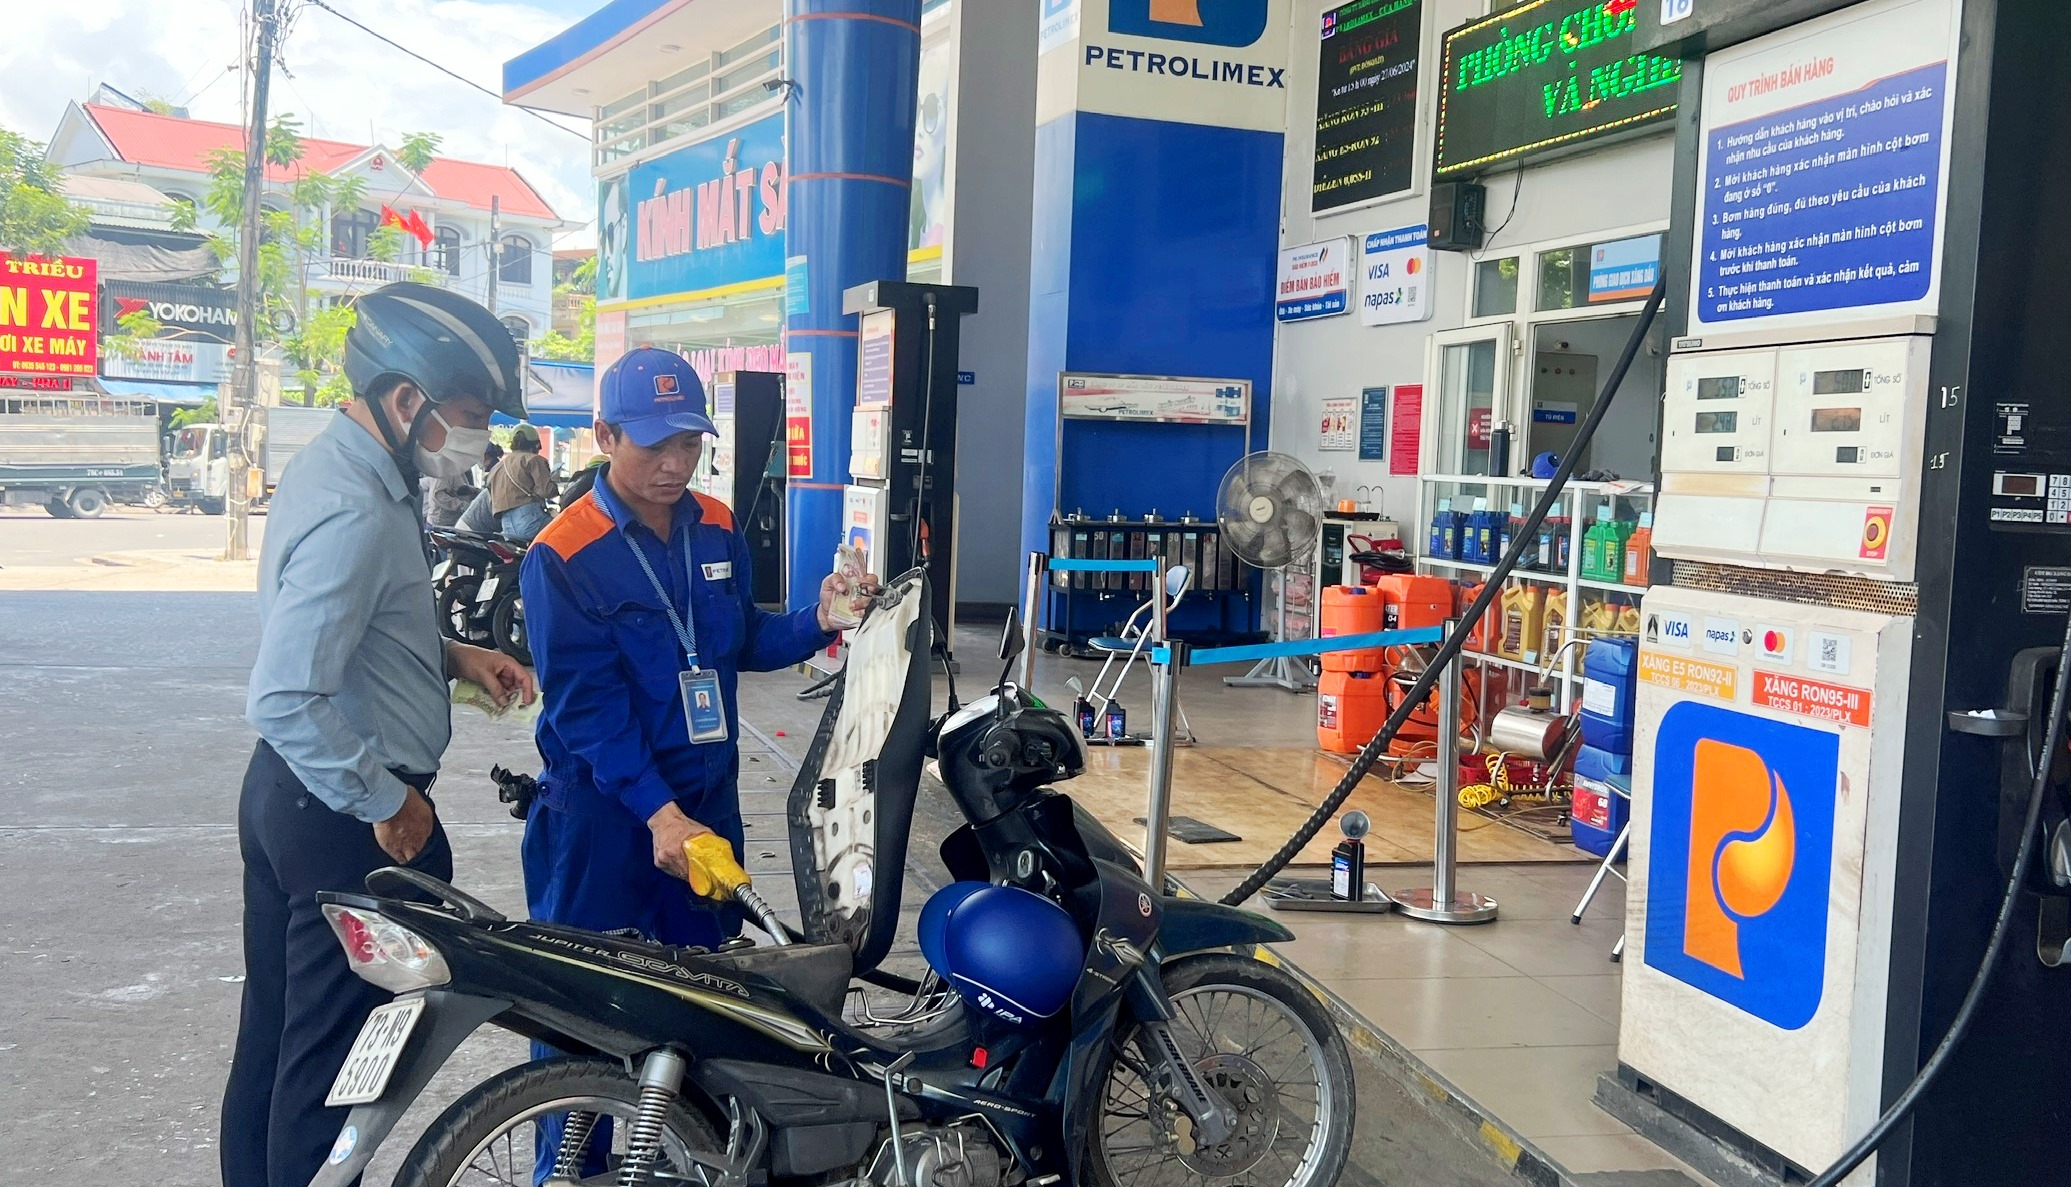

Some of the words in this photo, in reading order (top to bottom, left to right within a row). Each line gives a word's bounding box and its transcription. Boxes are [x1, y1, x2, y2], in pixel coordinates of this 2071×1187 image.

[1085, 44, 1285, 89] PETROLIMEX
[1727, 82, 1746, 103] QUY
[1748, 72, 1778, 98] TRÌNH
[1780, 63, 1802, 88] BÁN
[1804, 56, 1834, 82] HÀNG
[1717, 138, 1724, 150] 1.
[1727, 132, 1754, 148] Hướng
[1754, 126, 1770, 140] dẫn
[1771, 121, 1794, 138] khách
[1796, 117, 1817, 134] hàng
[1819, 112, 1834, 126] vào
[1836, 110, 1844, 124] vị
[1860, 98, 1882, 116] chào
[1914, 86, 1932, 100] xác
[1726, 150, 1744, 165] nhận
[1746, 148, 1761, 160] nhu
[1794, 133, 1819, 148] khách
[1821, 128, 1845, 144] hàng.
[1714, 178, 1722, 189] 2.
[1725, 172, 1741, 187] Mời
[1742, 166, 1768, 182] khách
[1770, 162, 1792, 179] hàng
[1794, 158, 1810, 171] xác
[1811, 152, 1835, 168] nhận
[1837, 146, 1858, 162] màn
[1860, 140, 1883, 157] hình
[1885, 136, 1902, 153] cột
[1905, 131, 1929, 146] bơm
[637, 178, 694, 262] KÍNH
[697, 138, 757, 250] MẮT
[1712, 214, 1719, 225] 3.
[1723, 211, 1742, 224] Bơm
[1743, 206, 1765, 221] hàng
[1767, 198, 1792, 218] đúng,
[1809, 192, 1830, 206] theo
[1831, 186, 1849, 206] yêu
[1851, 182, 1869, 200] cầu
[1872, 180, 1890, 195] của
[1893, 173, 1926, 191] khách
[1724, 188, 1742, 204] đang
[1366, 236, 1380, 250] CHẤP
[1380, 234, 1395, 248] NHẬN
[1396, 232, 1412, 246] THANH
[1710, 252, 1717, 262] 4.
[1720, 247, 1736, 261] Mời
[1738, 242, 1763, 258] khách
[1765, 240, 1786, 255] hàng
[1788, 236, 1805, 249] xác
[1807, 232, 1830, 248] nhận
[1832, 228, 1852, 243] màn
[1854, 224, 1876, 239] hình
[1879, 220, 1896, 236] cột
[1899, 216, 1922, 232] bơm
[1721, 226, 1742, 240] hàng.
[5, 258, 84, 279] TRIỀU
[1368, 263, 1389, 280] VISA
[1720, 263, 1741, 277] trước
[1742, 260, 1754, 274] khi
[1755, 257, 1777, 271] thanh
[1778, 255, 1798, 268] toán.
[1280, 275, 1295, 294] ĐIỂM
[1296, 274, 1308, 292] BÁN
[1310, 270, 1322, 290] BẢO
[1323, 268, 1340, 288] HIỂM
[1708, 288, 1715, 298] 5.
[1718, 284, 1738, 298] Thực
[1740, 280, 1756, 296] hiện
[1758, 278, 1782, 293] thanh
[1784, 274, 1802, 288] toán
[1816, 270, 1832, 284] xác
[1834, 268, 1856, 283] nhận
[1859, 263, 1873, 279] kết
[1898, 258, 1919, 274] cảm
[40, 289, 90, 331] XE
[1364, 290, 1394, 310] napas
[1728, 300, 1751, 312] khách
[1752, 296, 1774, 310] hàng.
[22, 336, 44, 354] XE
[50, 336, 86, 356] MÁY
[169, 350, 193, 364] TÂM
[1748, 382, 1761, 390] TỔNG
[1874, 374, 1890, 384] TỔNG
[1892, 373, 1902, 383] SỐ
[1941, 386, 1960, 408] 15
[1752, 416, 1761, 425] LÍT
[1880, 412, 1890, 423] LÍT
[1930, 452, 1949, 469] 15
[2053, 477, 2057, 485] 7
[2063, 477, 2067, 485] 8
[2052, 489, 2056, 497] 4
[2061, 501, 2065, 509] 2
[1094, 532, 1103, 540] 50
[1664, 620, 1689, 638] VISA
[1706, 629, 1729, 642] napas
[1642, 653, 1670, 672] XĂNG
[1672, 660, 1685, 674] E5
[1687, 663, 1732, 686] RON92-II
[1651, 672, 1670, 686] TCCS
[1686, 681, 1720, 697] 2023/PLX
[1764, 676, 1799, 698] XĂNG
[1802, 686, 1858, 710] RON95-III
[1768, 695, 1791, 709] TCCS
[1792, 702, 1803, 712] 01
[1810, 704, 1851, 723] 2023/PLX
[1598, 797, 1608, 808] 68
[529, 934, 610, 957] JUPITER
[618, 951, 750, 997] GRAVITA
[359, 1008, 412, 1054] 73-N9
[338, 1053, 390, 1096] 5900
